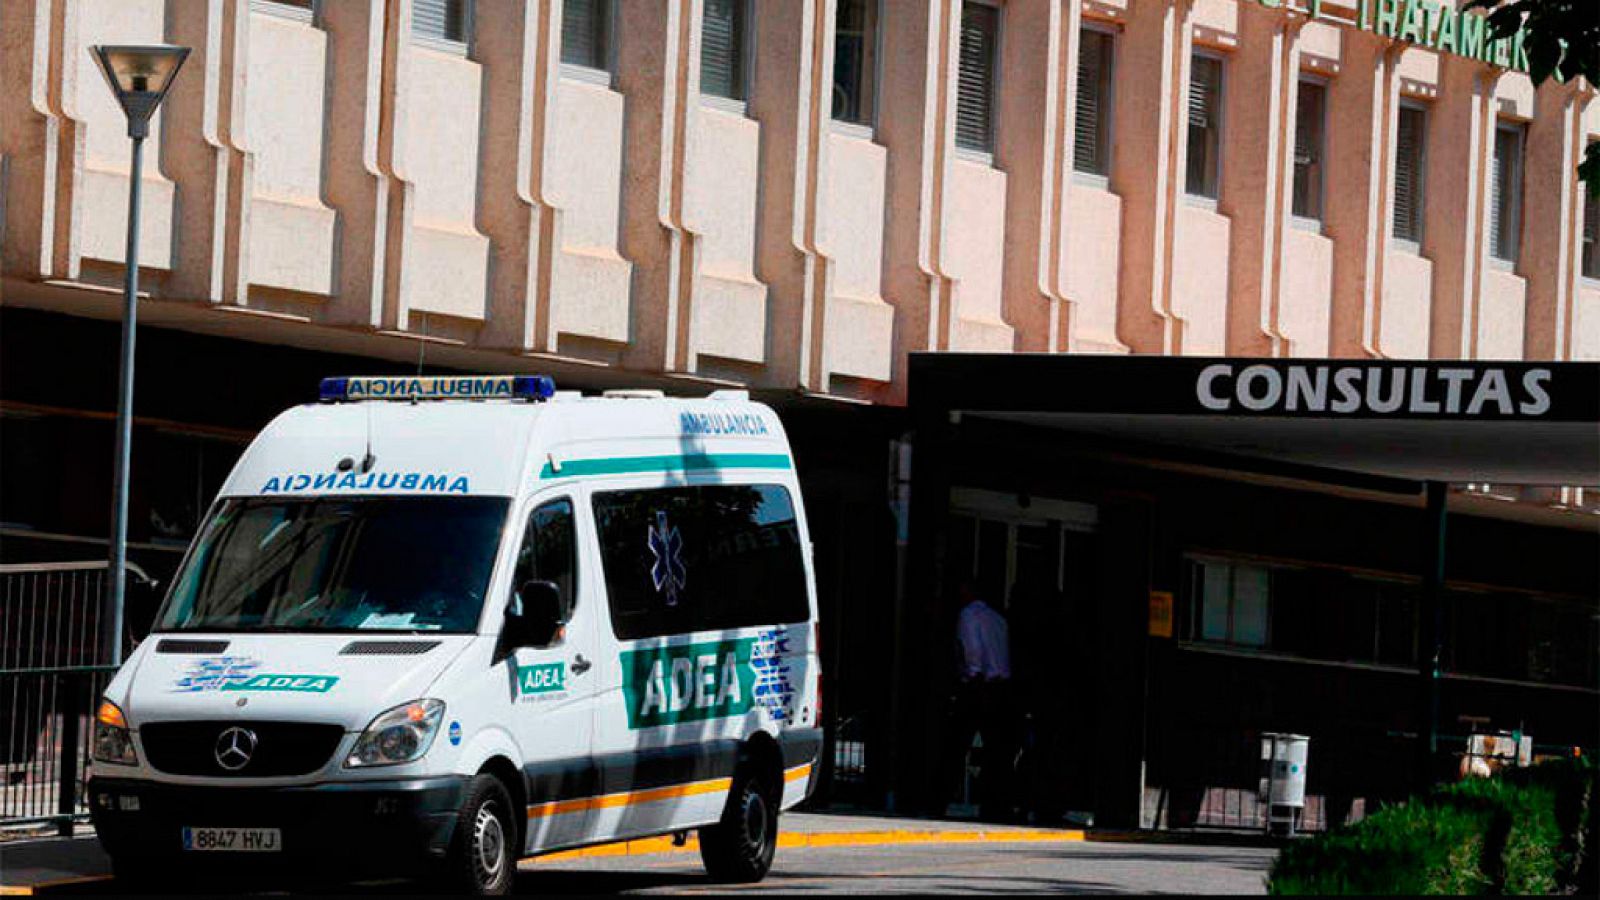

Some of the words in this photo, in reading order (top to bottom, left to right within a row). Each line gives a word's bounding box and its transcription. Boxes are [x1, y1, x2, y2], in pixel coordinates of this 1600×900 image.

[1196, 364, 1551, 415] CONSULTAS
[680, 412, 767, 434] AMBULANCIA
[249, 677, 328, 689] ADEA
[525, 668, 560, 688] ADEA
[640, 652, 741, 716] ADEA
[241, 830, 275, 849] HVJ
